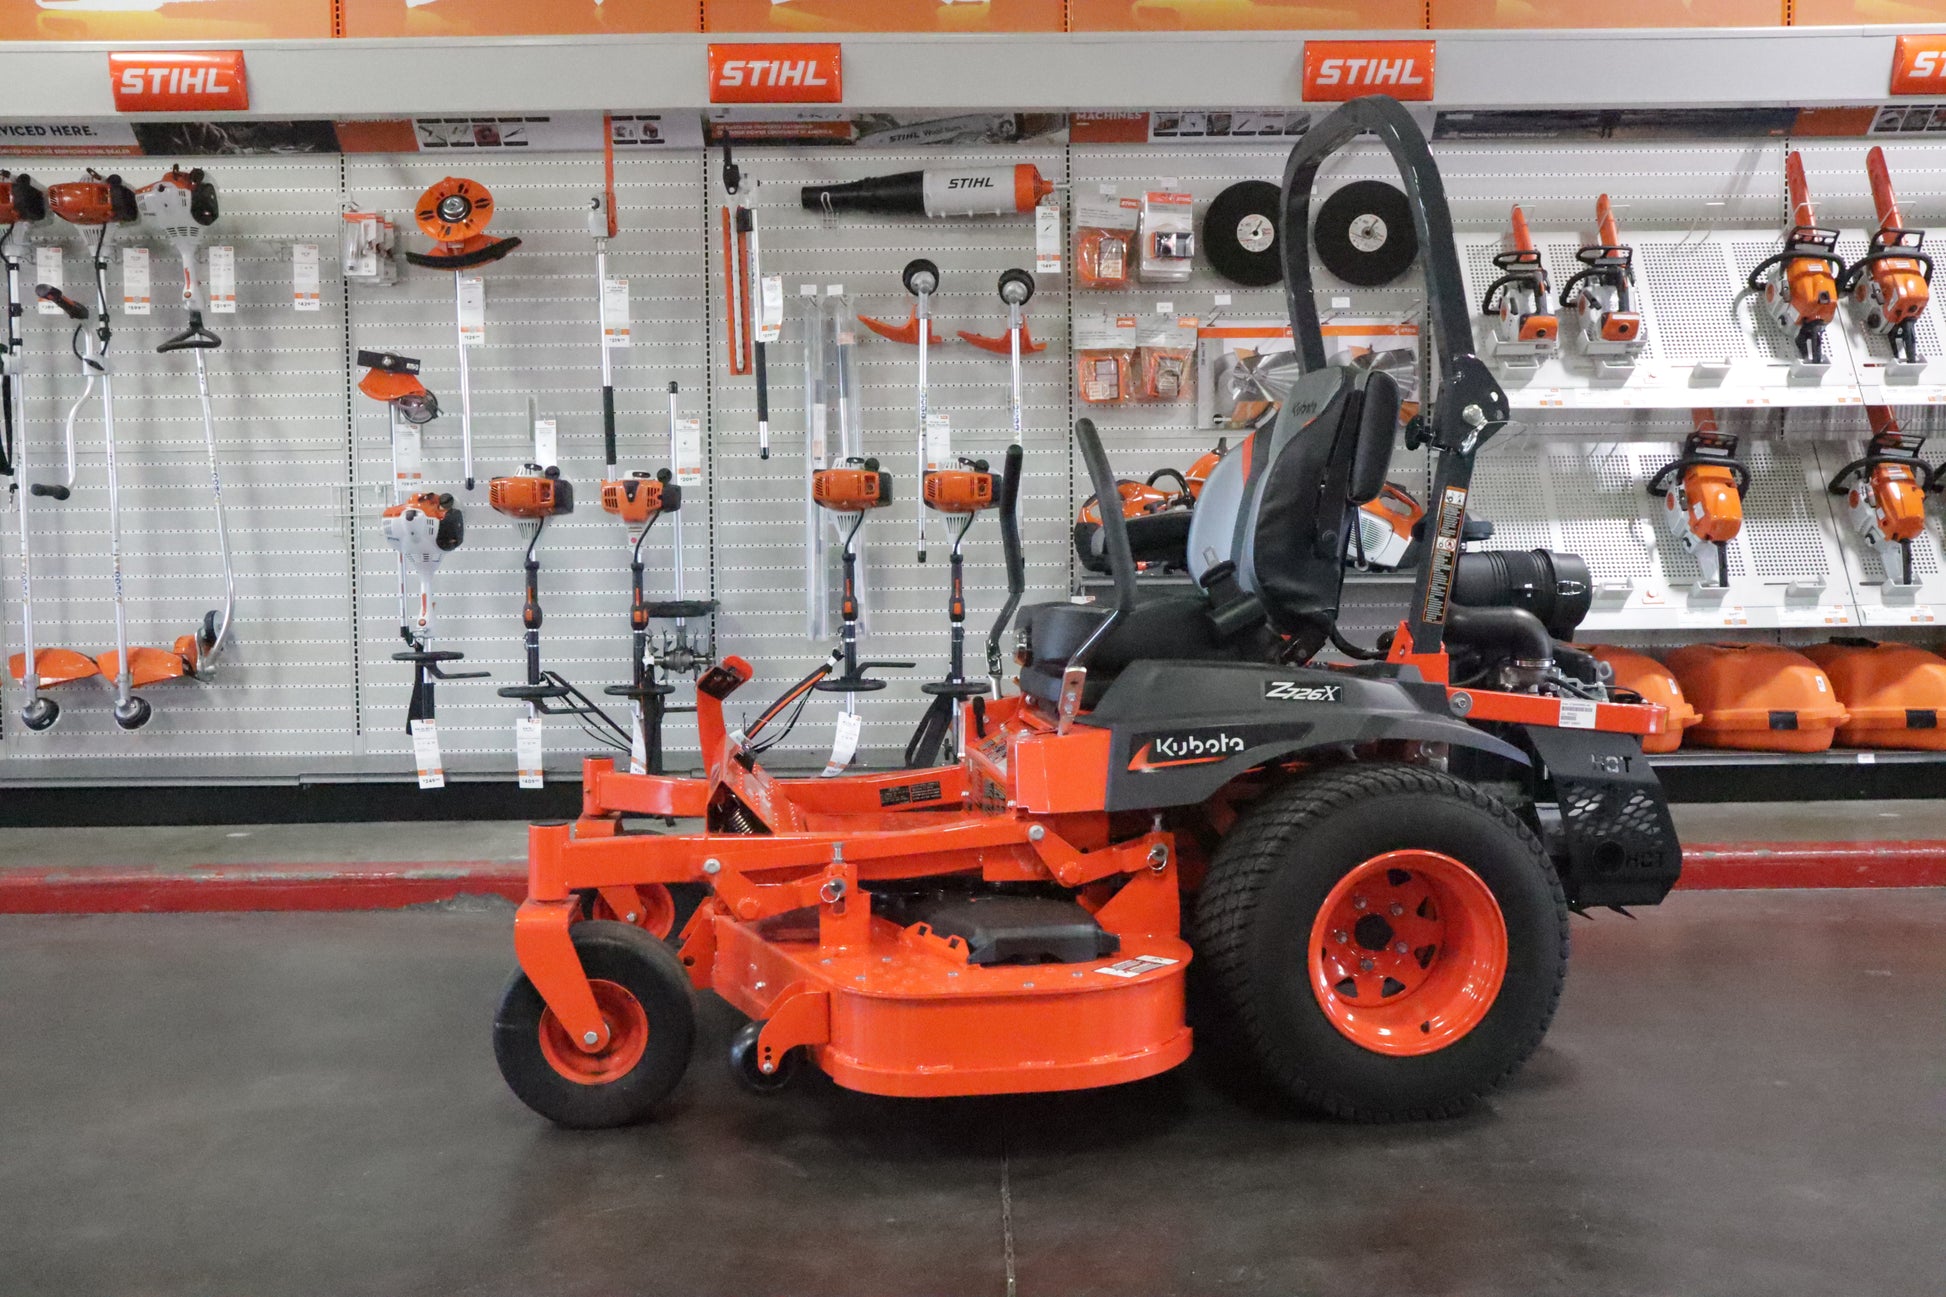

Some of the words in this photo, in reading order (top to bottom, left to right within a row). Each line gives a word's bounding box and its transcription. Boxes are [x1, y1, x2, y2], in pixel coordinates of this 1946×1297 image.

[121, 68, 230, 94] STIHL
[719, 60, 828, 86] STIHL
[1316, 59, 1424, 85] STIHL
[1076, 111, 1142, 120] MACHINES
[0, 125, 46, 136] VICED
[50, 125, 98, 136] HERE.
[889, 132, 920, 143] STIHL
[948, 177, 994, 189] STIHL
[1265, 681, 1341, 701] Z726X
[1156, 733, 1245, 756] Kubota
[1591, 754, 1632, 773] HOT
